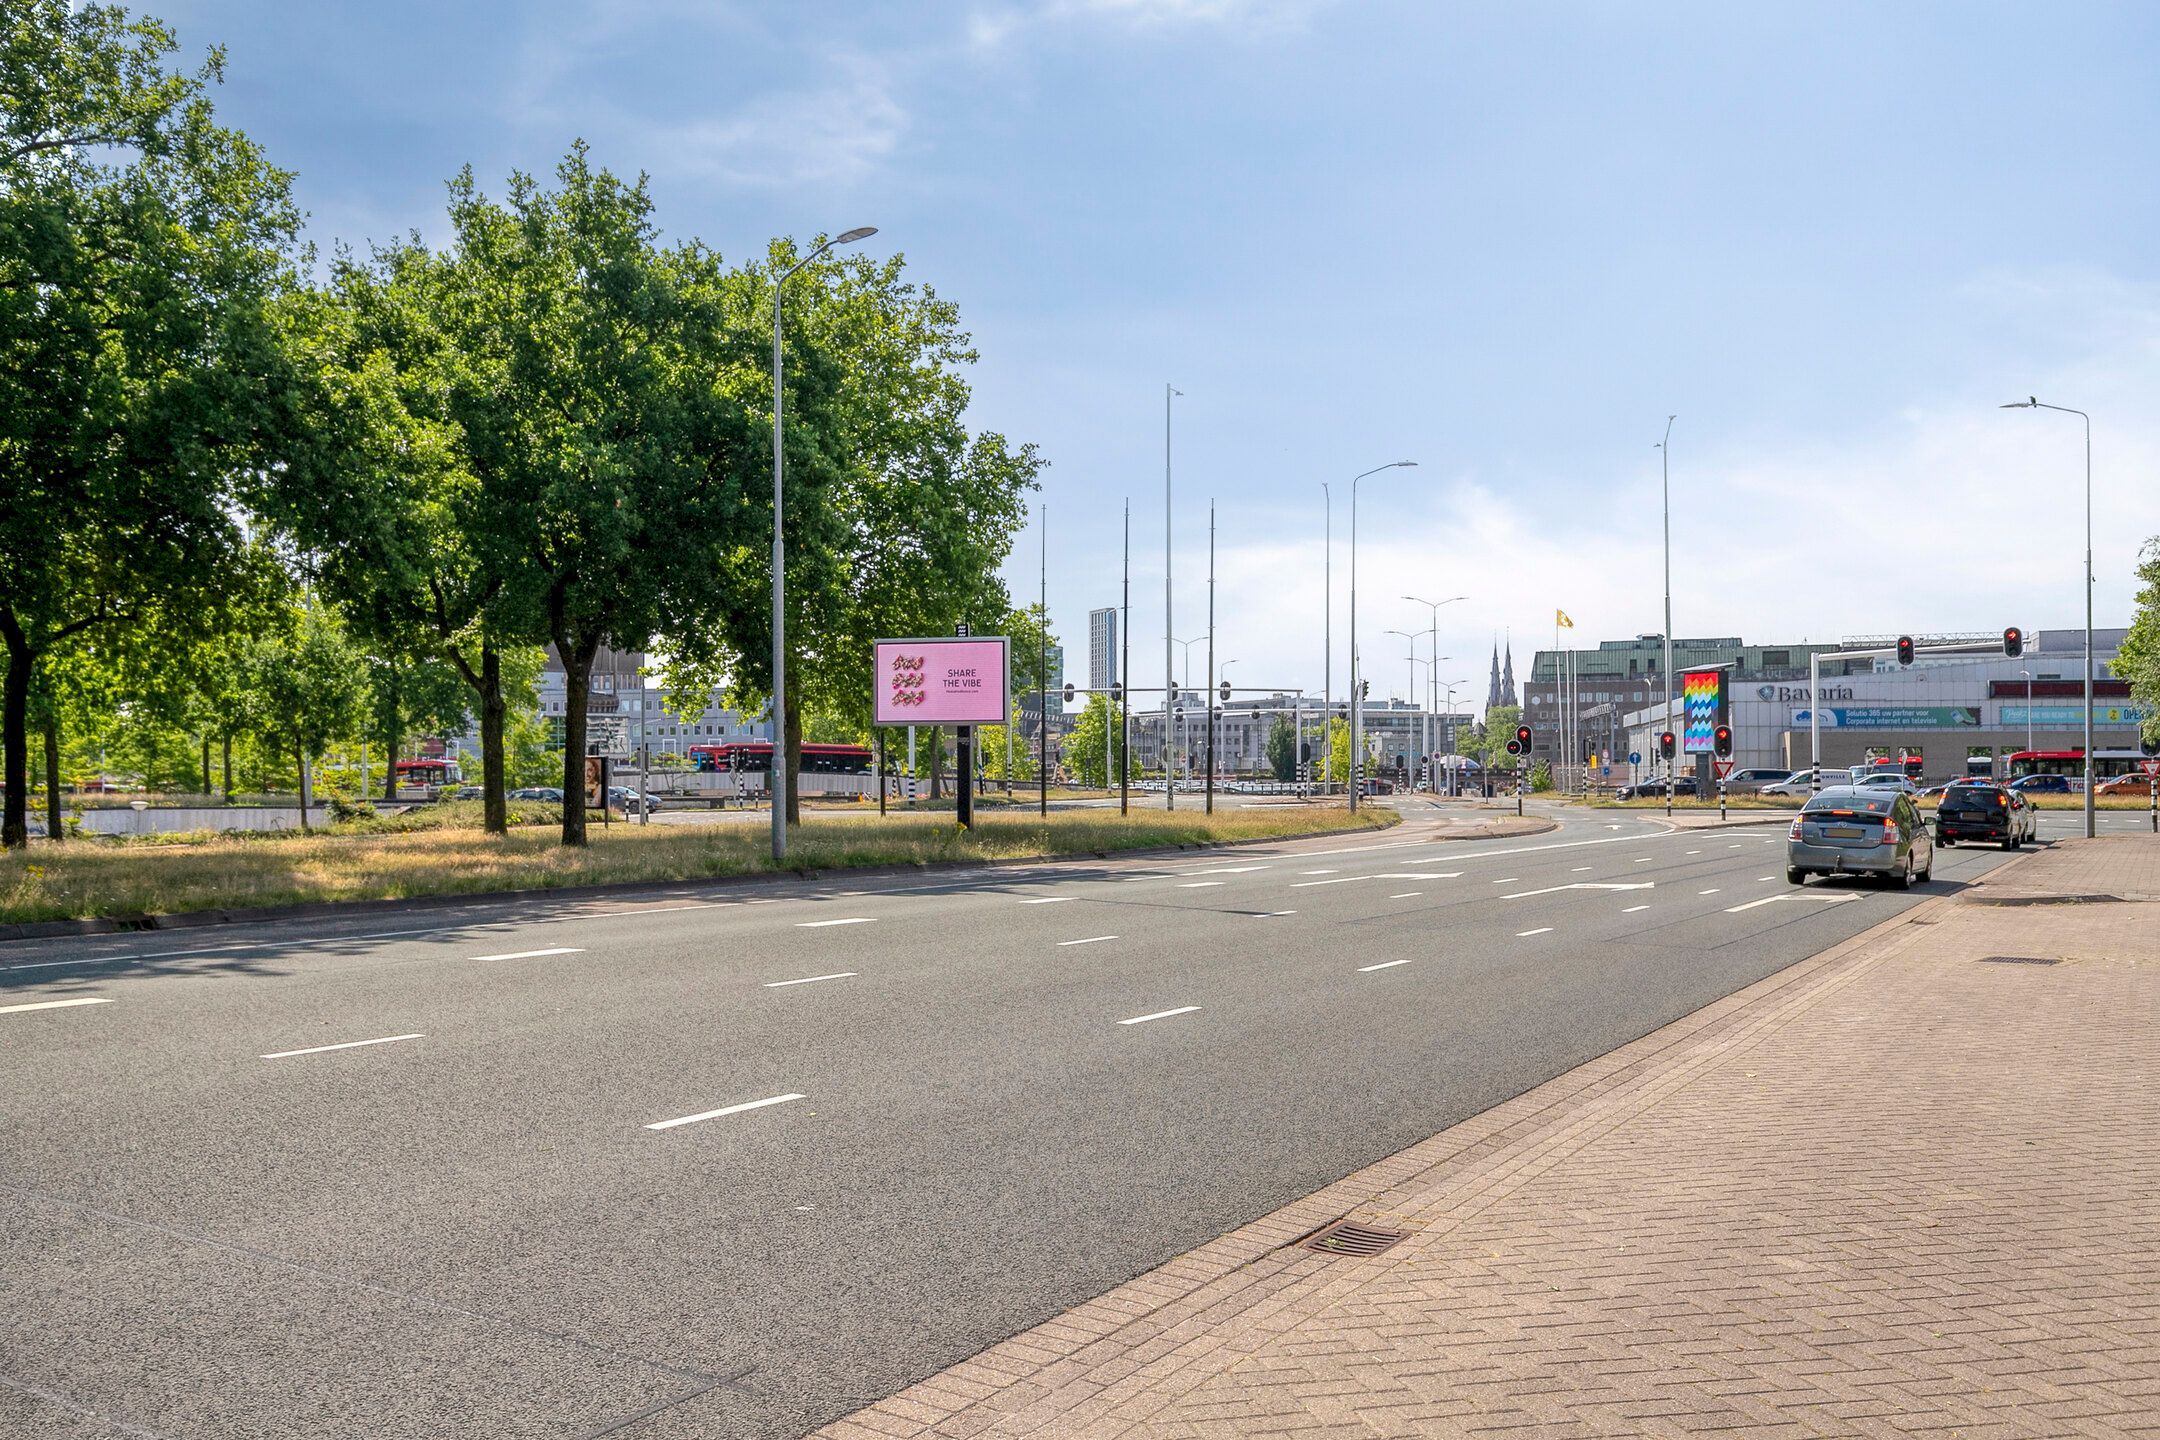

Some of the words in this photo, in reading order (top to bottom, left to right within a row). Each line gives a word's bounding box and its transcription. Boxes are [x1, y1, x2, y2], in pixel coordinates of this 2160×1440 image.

[947, 668, 976, 678] SHARE
[943, 679, 960, 688] THE
[962, 679, 982, 688] VIBE
[1778, 684, 1853, 702] Bavaria
[1846, 709, 1868, 717] Solutio
[1868, 709, 1881, 717] 365
[1892, 709, 1915, 718] partner
[1846, 717, 1875, 726] Corporate
